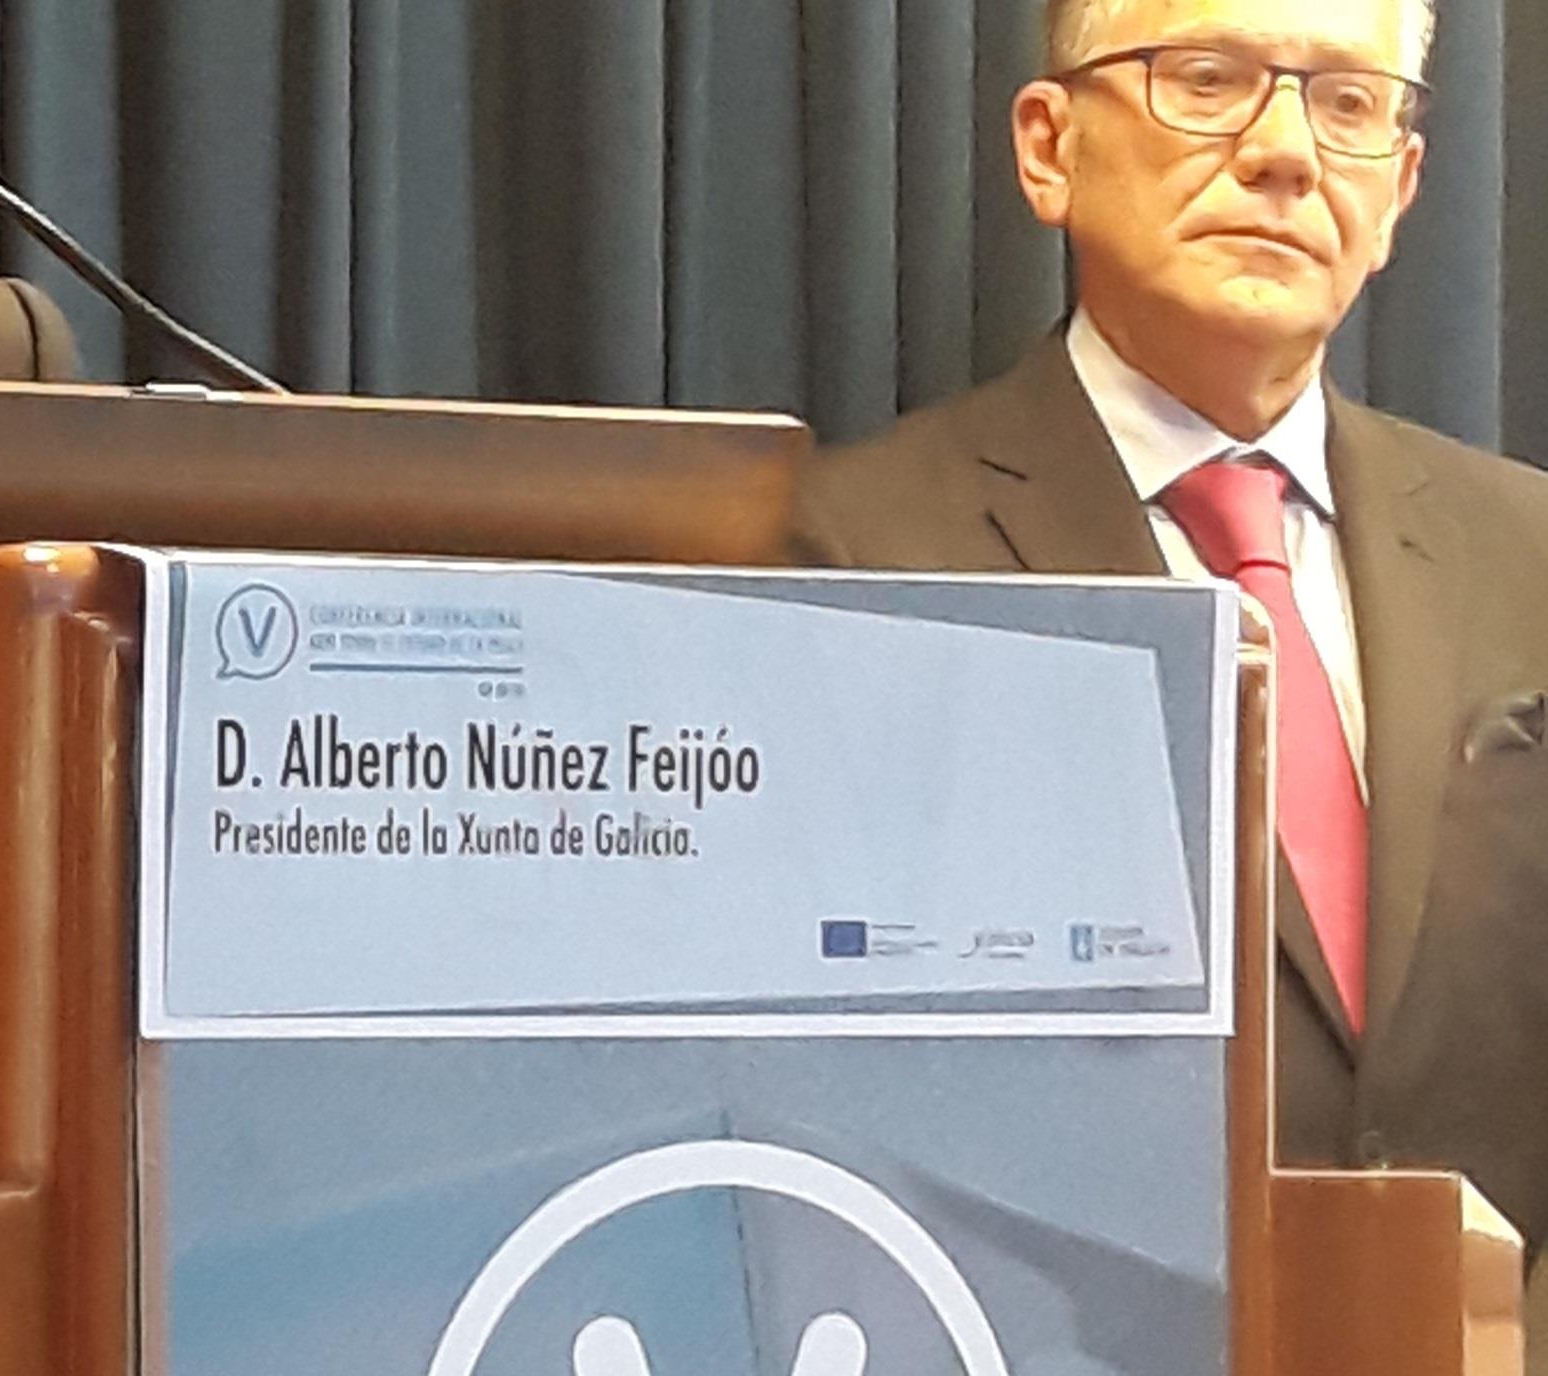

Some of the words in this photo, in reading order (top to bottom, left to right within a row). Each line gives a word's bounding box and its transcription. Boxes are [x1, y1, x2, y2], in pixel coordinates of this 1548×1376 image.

[238, 605, 278, 658] V
[216, 718, 263, 789] D.
[279, 713, 448, 791] Alberto
[466, 721, 610, 792] Núñez
[627, 723, 761, 811] Feijóo
[214, 807, 367, 855] Presidente
[376, 807, 411, 855] de
[422, 807, 449, 856] la
[457, 811, 540, 856] Xunta
[550, 808, 585, 856] de
[595, 810, 701, 858] Galicia.
